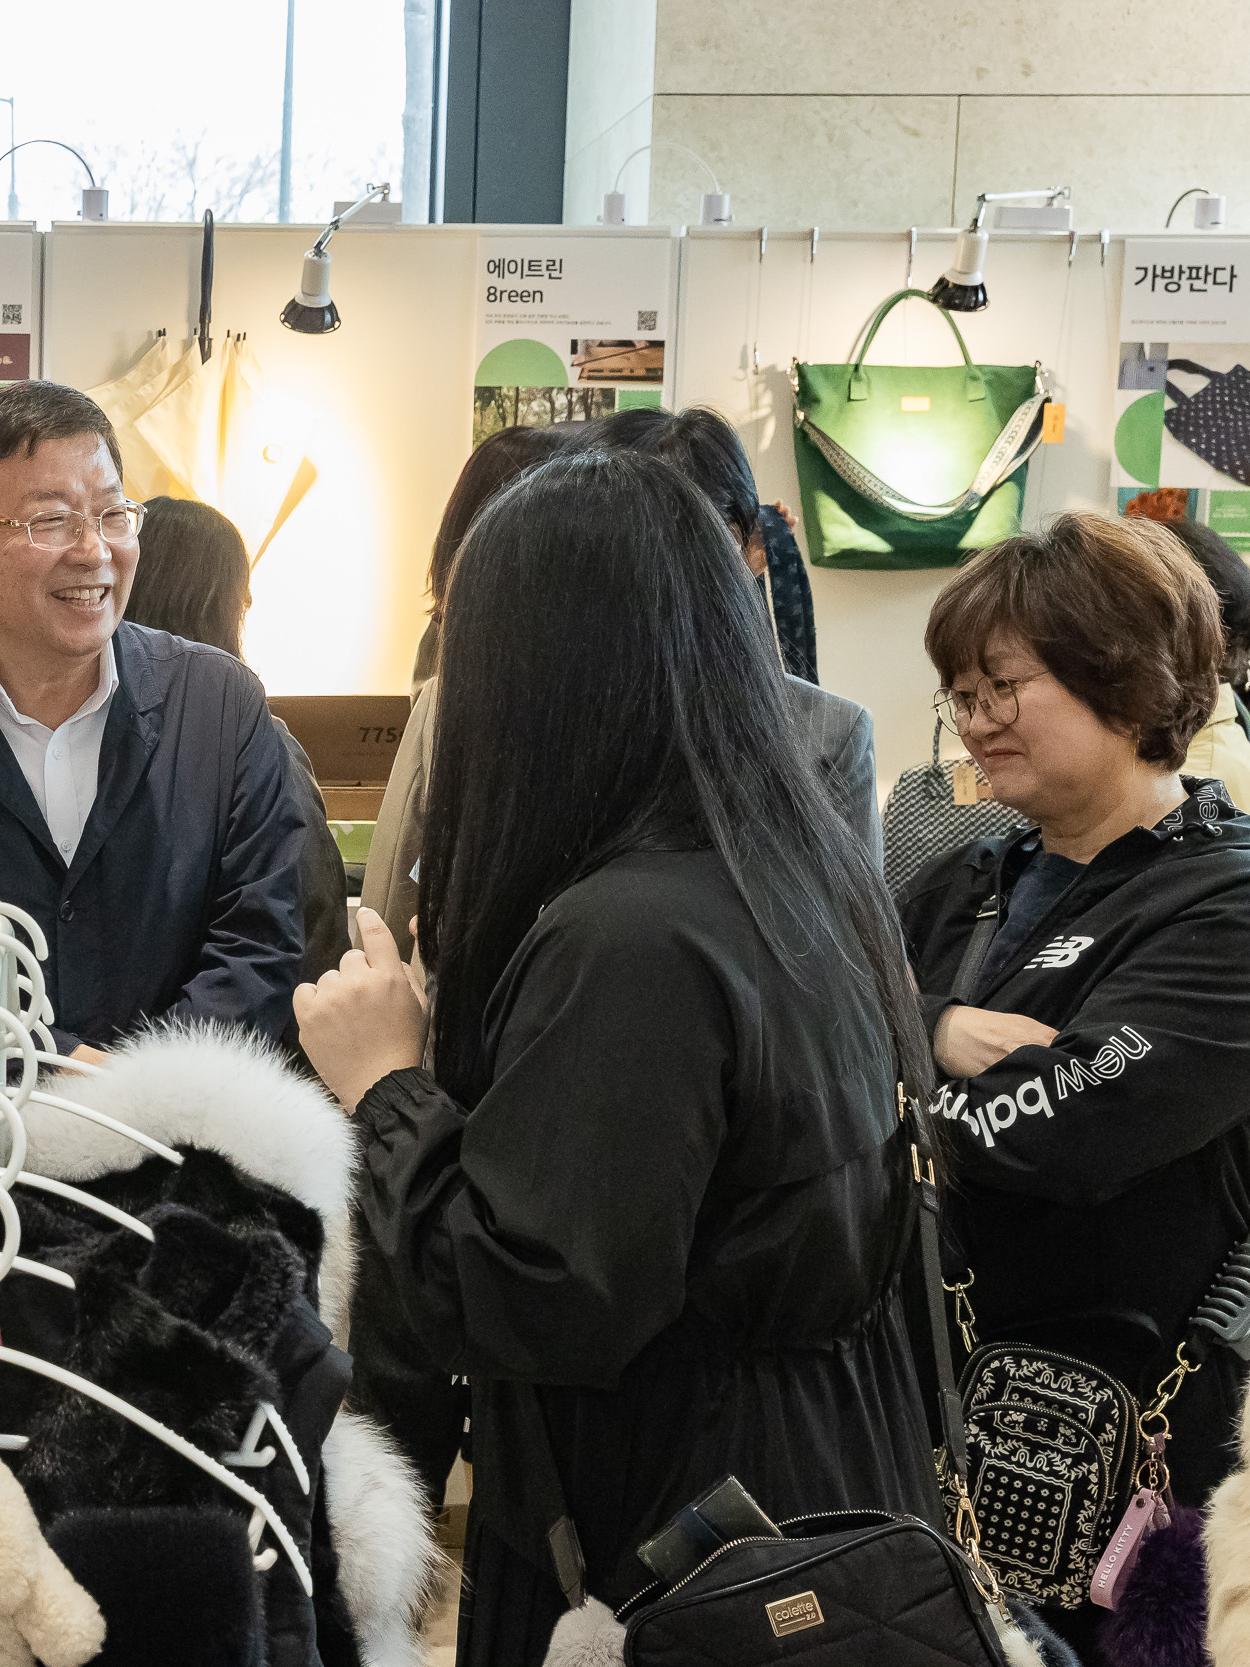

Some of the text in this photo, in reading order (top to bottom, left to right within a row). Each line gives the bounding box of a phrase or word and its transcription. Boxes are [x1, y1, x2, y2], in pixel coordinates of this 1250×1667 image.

[486, 257, 563, 280] 에이트린
[1134, 264, 1238, 293] 가방판다
[486, 286, 544, 304] 8reen
[1053, 1025, 1153, 1100] new
[1097, 1523, 1133, 1589] HELLO KITTY
[775, 1602, 814, 1621] colette
